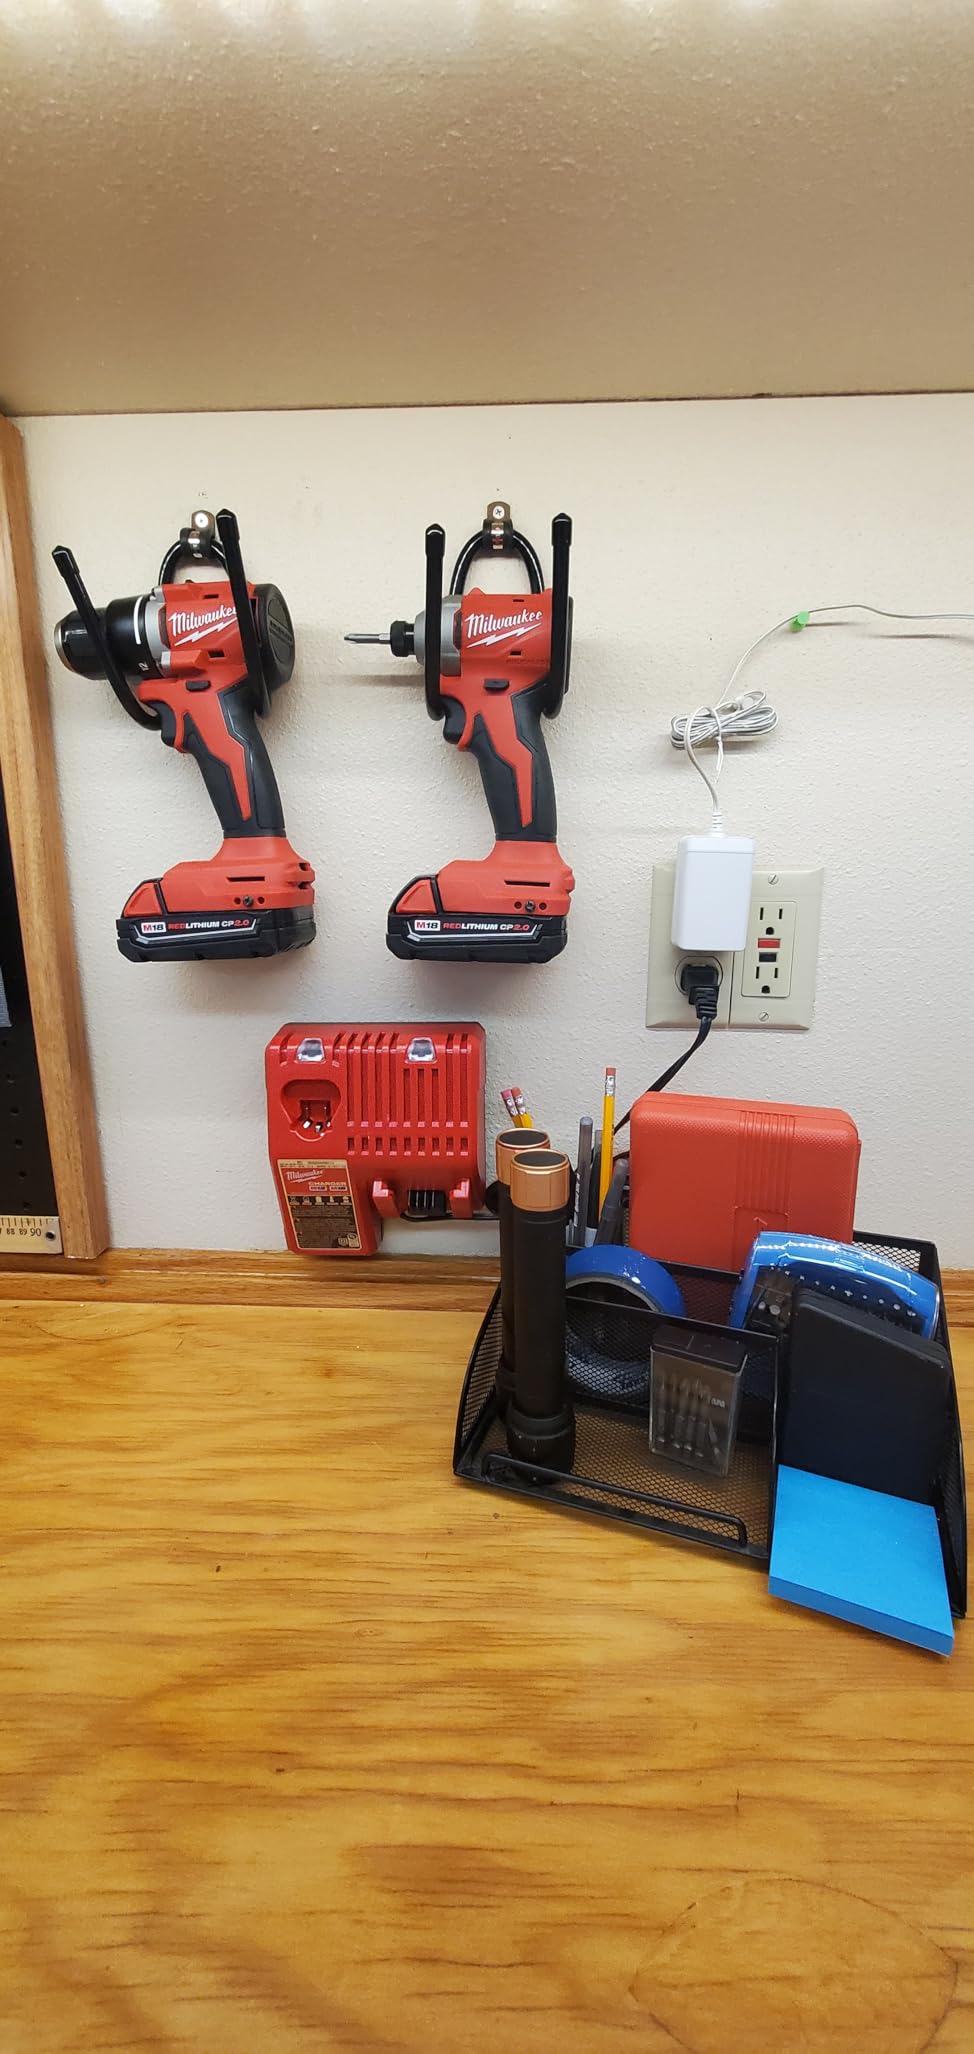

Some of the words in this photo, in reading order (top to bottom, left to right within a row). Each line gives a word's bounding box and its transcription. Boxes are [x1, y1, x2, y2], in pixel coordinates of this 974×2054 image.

[465, 608, 543, 638] Milwaukee
[143, 923, 164, 932] M18
[168, 921, 220, 930] REDLITHIUM
[221, 919, 250, 929] CP2.0
[416, 921, 439, 929] M18
[443, 922, 498, 931] REDLITHIUM
[500, 923, 530, 931] CP2.0
[19, 1228, 28, 1236] 89
[30, 1227, 42, 1237] 90
